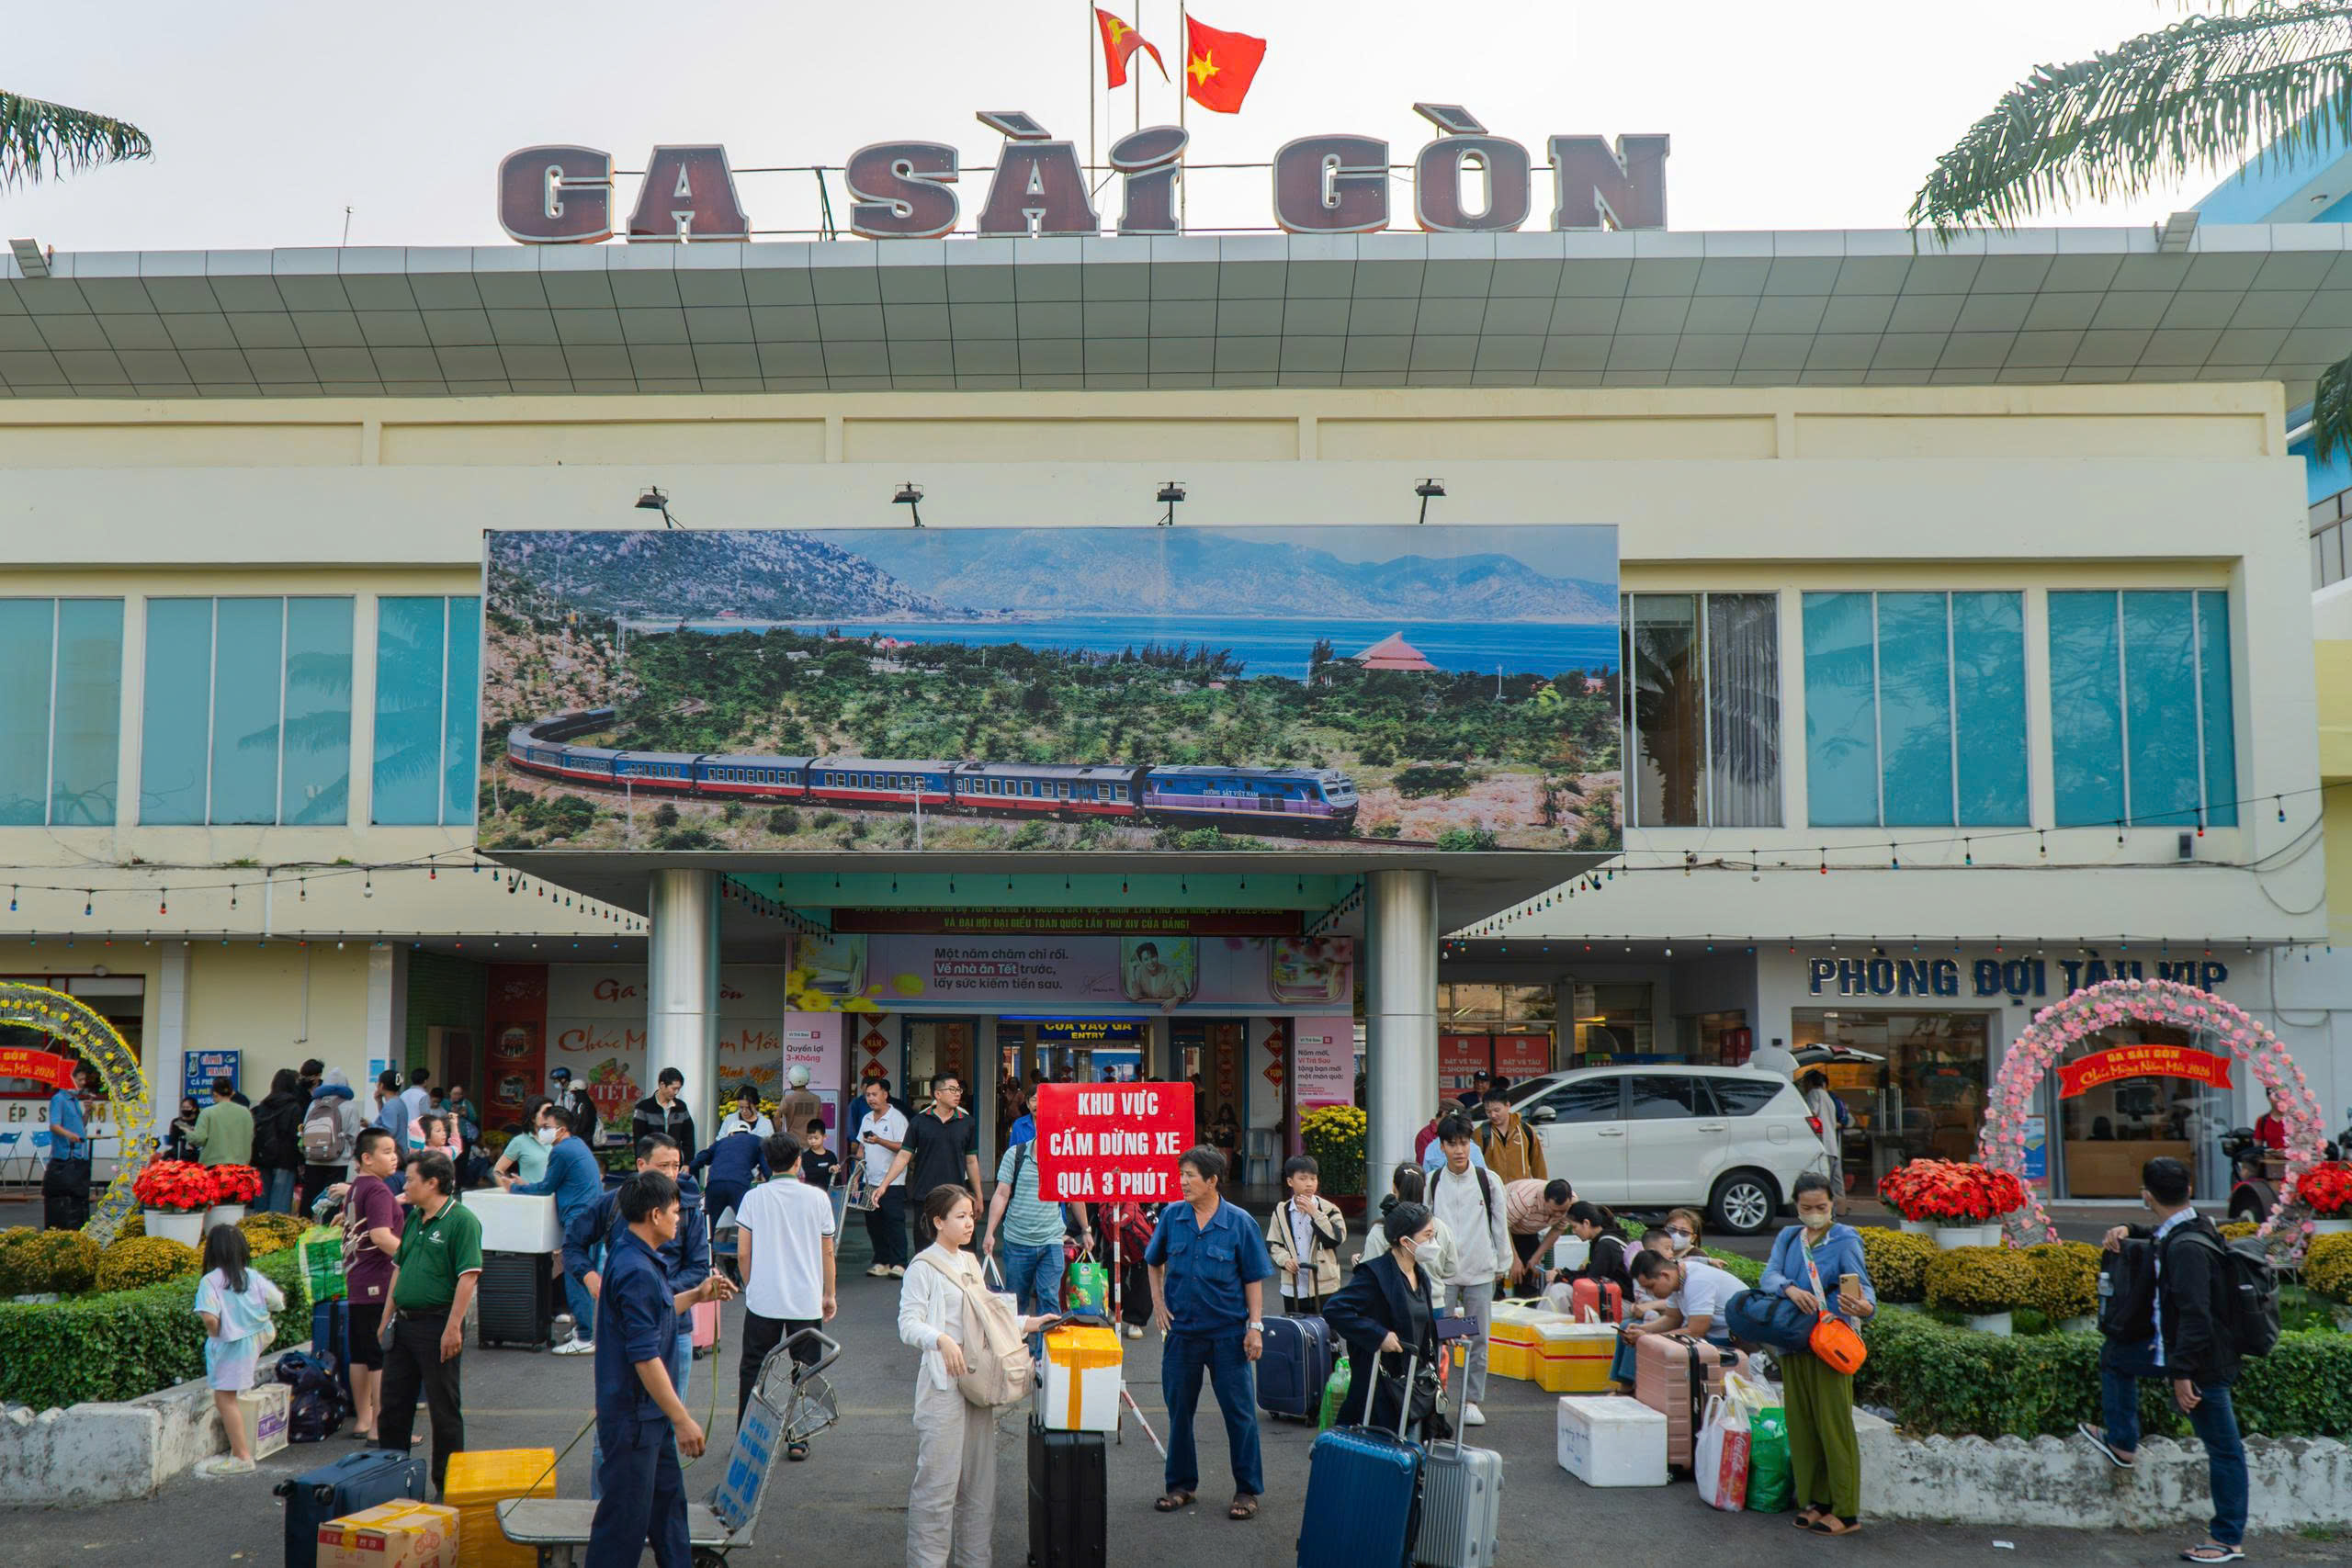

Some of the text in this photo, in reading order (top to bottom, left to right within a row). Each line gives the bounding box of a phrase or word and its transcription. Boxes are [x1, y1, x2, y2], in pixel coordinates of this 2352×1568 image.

[498, 144, 752, 244] GA
[1272, 103, 1670, 233] GÒN
[934, 948, 959, 961] Một
[962, 949, 990, 959] năm
[991, 948, 1025, 959] chăm
[1028, 948, 1046, 959] chỉ
[954, 963, 977, 974] nhà
[979, 964, 994, 974] ăn
[998, 963, 1018, 975] Tết
[1021, 964, 1057, 976] trước,
[1808, 949, 1960, 997] PHÒNG
[1973, 955, 2047, 1005] ĐỢI
[2155, 959, 2228, 994] VIP
[594, 978, 637, 1002] Ga
[933, 976, 952, 989] lấy
[956, 977, 977, 988] sức
[980, 976, 1009, 988] kiếm
[1038, 979, 1063, 989] sau.
[559, 1024, 622, 1052] Chúc
[742, 1028, 780, 1052] Mới
[1070, 1032, 1105, 1040] ENTRY
[813, 1044, 824, 1054] lợi
[786, 1055, 821, 1063] 3-Không
[2188, 1065, 2211, 1077] 2026
[1078, 1089, 1159, 1121] KHU VỰC
[1050, 1126, 1181, 1156] CẤM DỪNG XE
[1057, 1168, 1169, 1198] QUÁ 3 PHÚT
